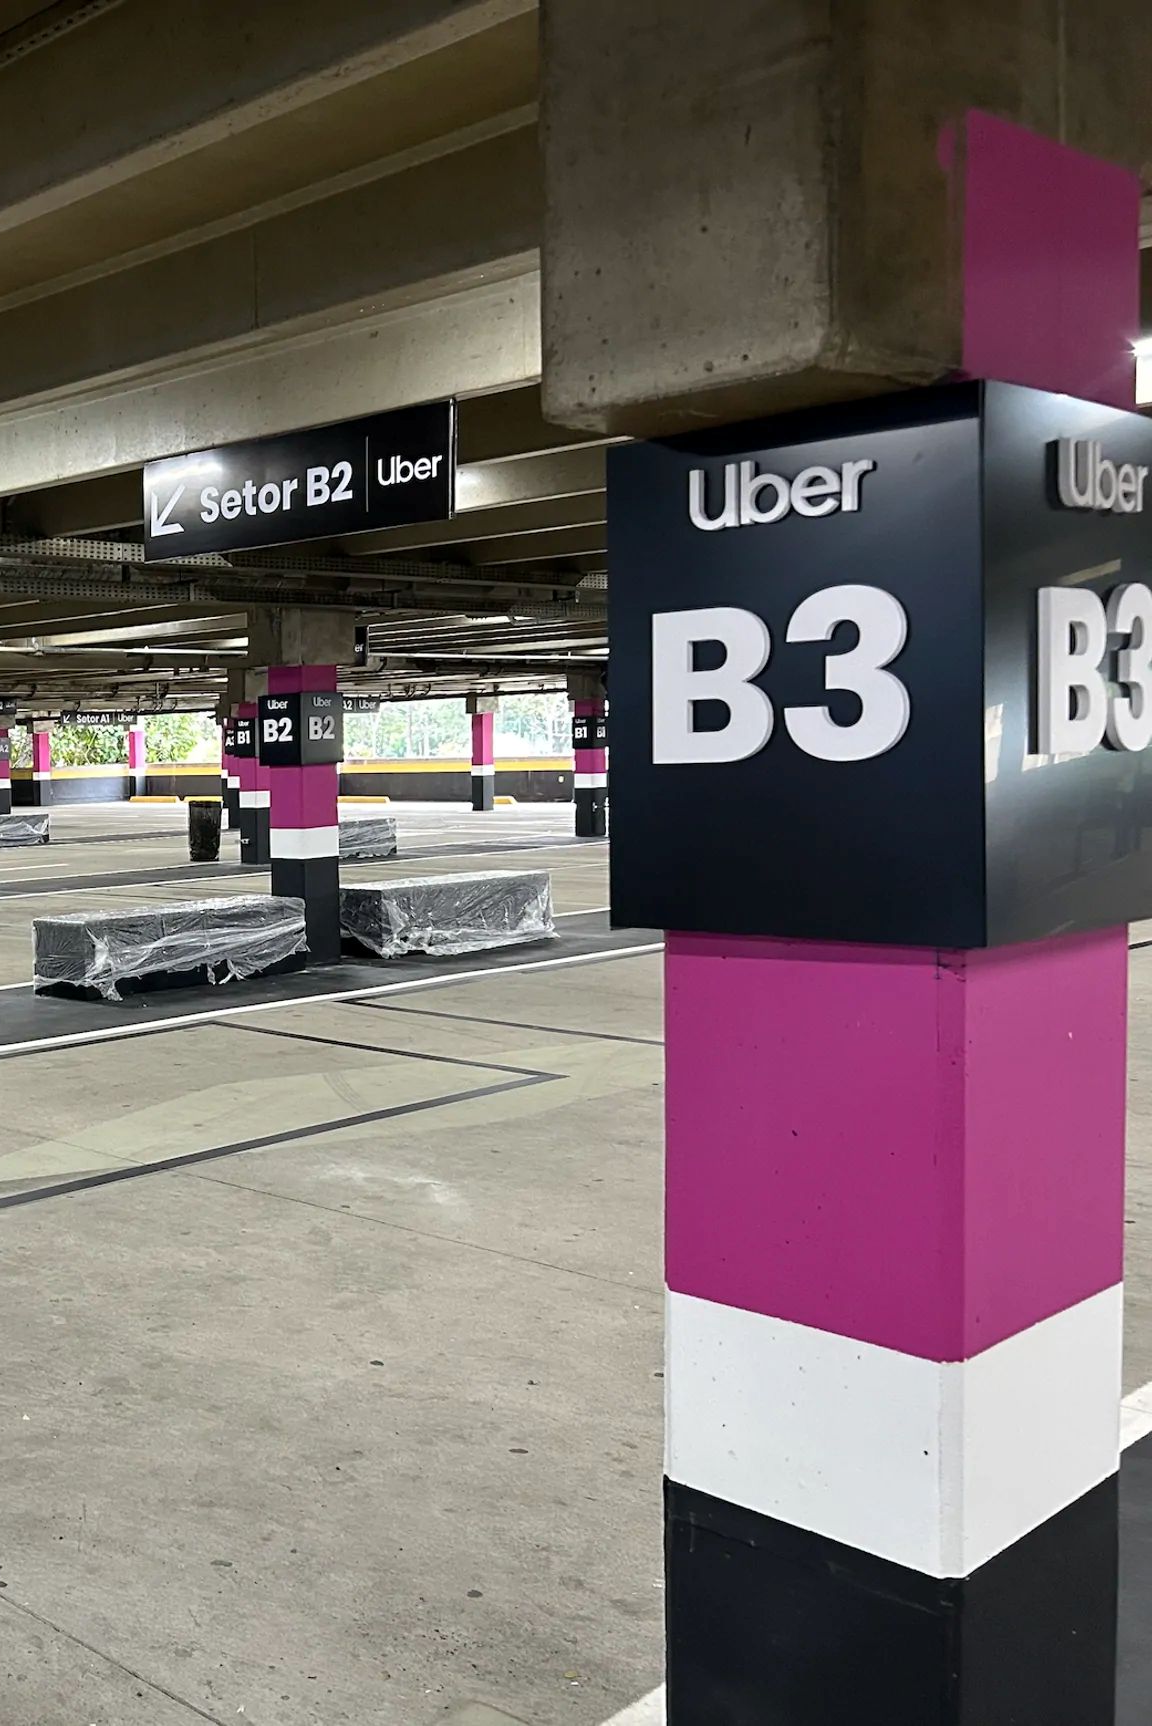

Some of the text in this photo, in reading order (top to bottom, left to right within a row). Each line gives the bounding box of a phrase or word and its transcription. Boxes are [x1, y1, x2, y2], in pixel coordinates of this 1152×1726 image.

[1056, 437, 1148, 513] Uber
[200, 454, 443, 524] Setor B2 Uber
[688, 459, 875, 531] Uber
[652, 584, 911, 765] B3
[1037, 582, 1152, 755] B3
[267, 699, 288, 710] Uber
[313, 697, 332, 707] Uber
[358, 699, 377, 710] Uber
[77, 713, 134, 724] Setor A1 Uber
[308, 715, 336, 740] B2
[237, 730, 250, 745] B1
[263, 717, 293, 743] B2
[575, 726, 588, 739] B1
[0, 745, 9, 753] A2
